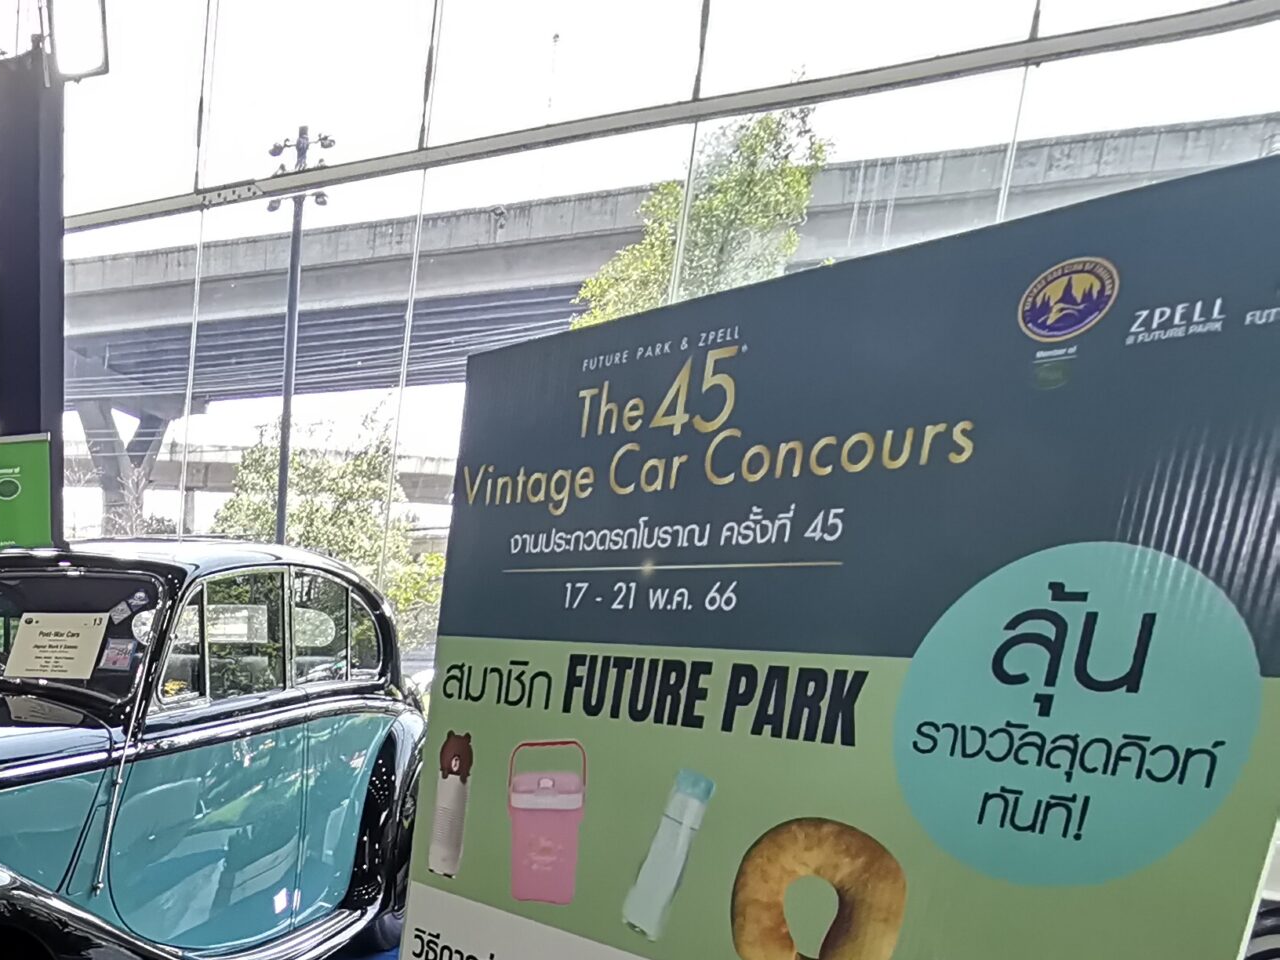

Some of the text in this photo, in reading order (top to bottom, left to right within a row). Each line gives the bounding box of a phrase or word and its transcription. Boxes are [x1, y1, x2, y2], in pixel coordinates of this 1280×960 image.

[1129, 297, 1227, 332] ZPELL
[1136, 325, 1186, 344] FUTURE
[582, 326, 739, 372] FUTURE PARK & ZPELL
[578, 380, 645, 439] The
[463, 420, 974, 516] Vintage Car Concours
[510, 504, 845, 555] งานประกวดรถโบราณ ครั้งที่ 45
[93, 617, 103, 626] 13
[564, 582, 588, 610] 17
[612, 582, 636, 611] 21
[648, 586, 693, 611] พ.ค.
[704, 581, 738, 611] 66
[991, 581, 1157, 717] ลุ้น
[442, 653, 869, 748] สมาชิก FUTURE PARK
[912, 720, 1226, 789] รางวัลสุดคิวท์
[976, 785, 1091, 841] ทันที!
